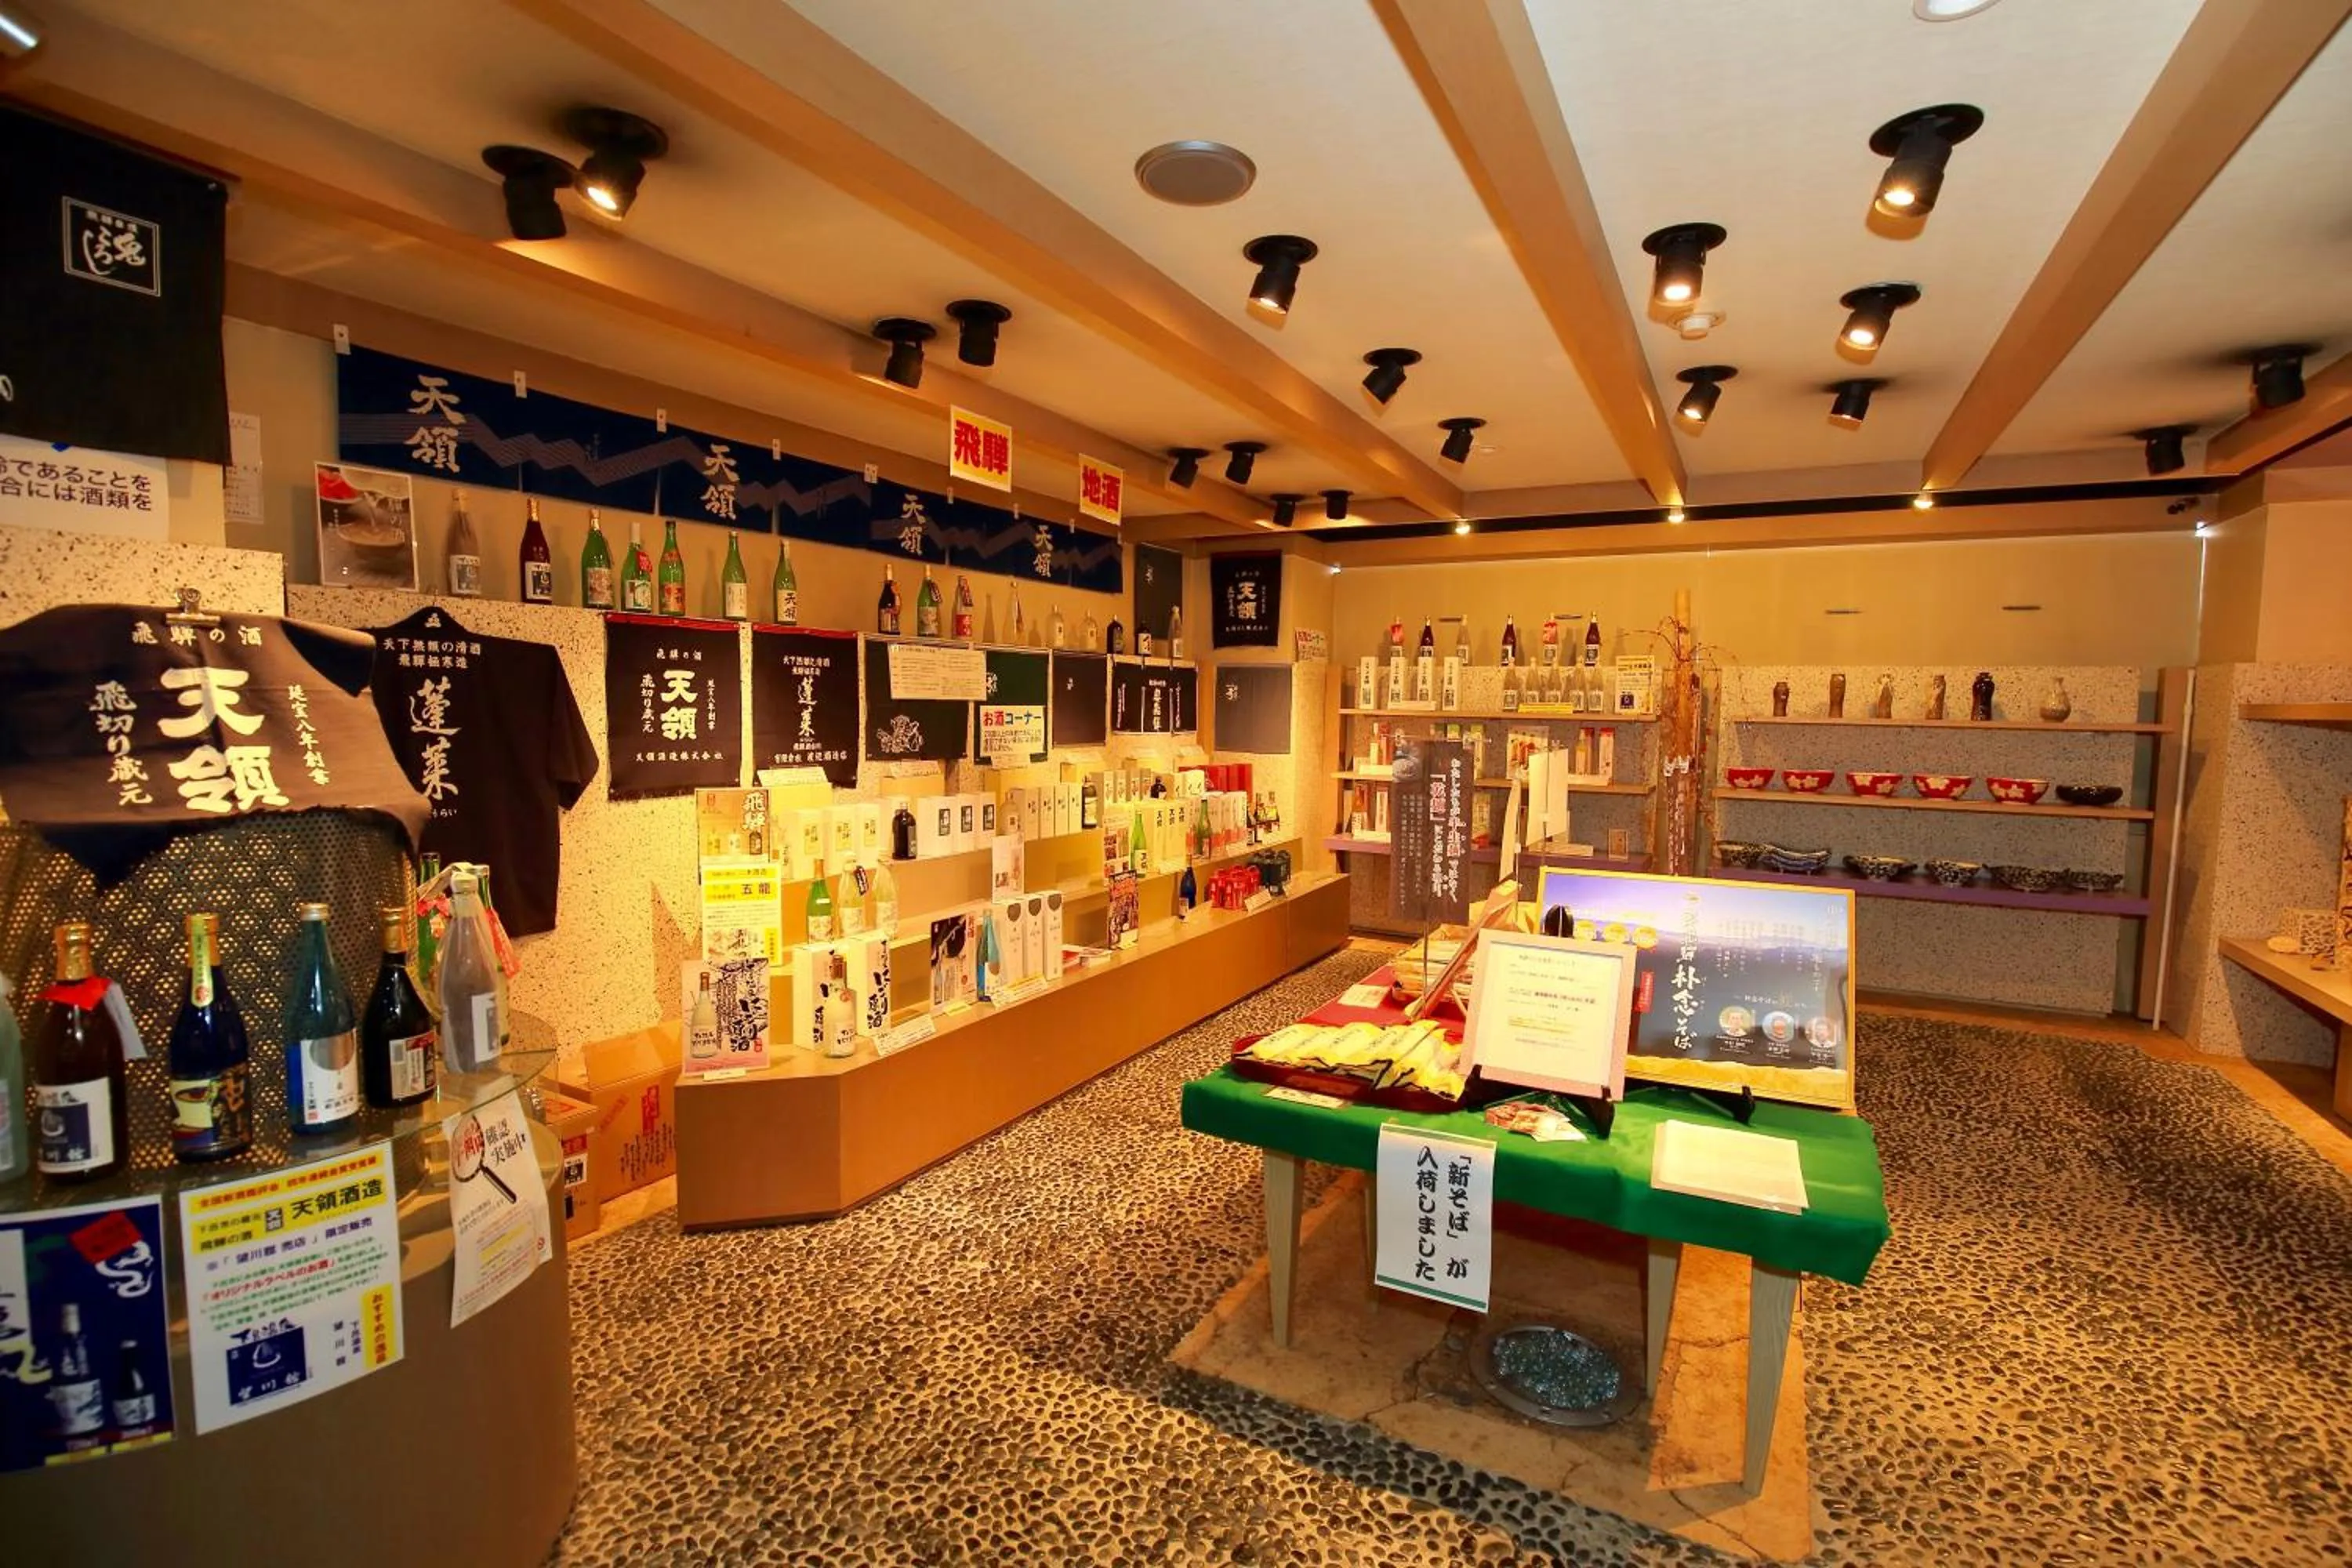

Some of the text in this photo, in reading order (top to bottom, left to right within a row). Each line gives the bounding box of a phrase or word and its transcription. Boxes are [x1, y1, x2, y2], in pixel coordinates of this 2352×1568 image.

[404, 375, 466, 474] 天領
[700, 444, 740, 521] 天領
[1082, 464, 1121, 513] 地酒
[898, 494, 926, 556] 天領
[1033, 525, 1053, 578] 天領
[1237, 581, 1257, 619] 天領
[659, 670, 699, 741] 天領
[983, 710, 1042, 726] お酒コーナー
[157, 666, 290, 814] 天領
[292, 1178, 383, 1220] 天領酒造
[1414, 1145, 1439, 1282] 入荷しました
[1446, 1258, 1469, 1279] が
